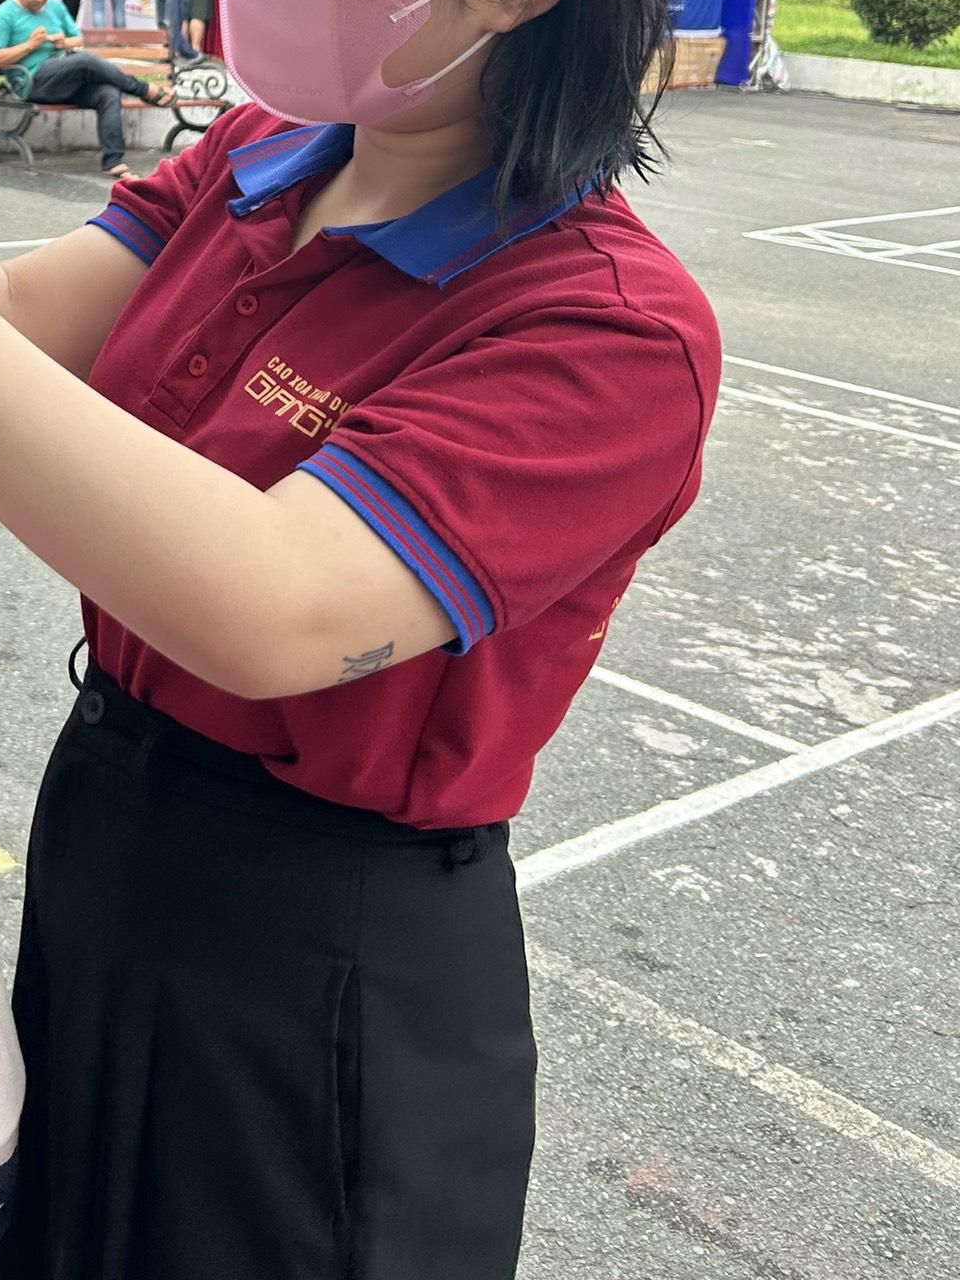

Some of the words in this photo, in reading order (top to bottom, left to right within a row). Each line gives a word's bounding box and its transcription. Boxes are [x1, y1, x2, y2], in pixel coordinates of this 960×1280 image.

[267, 356, 293, 380] CAO
[288, 375, 313, 396] XOA
[244, 370, 337, 438] GIANG'
